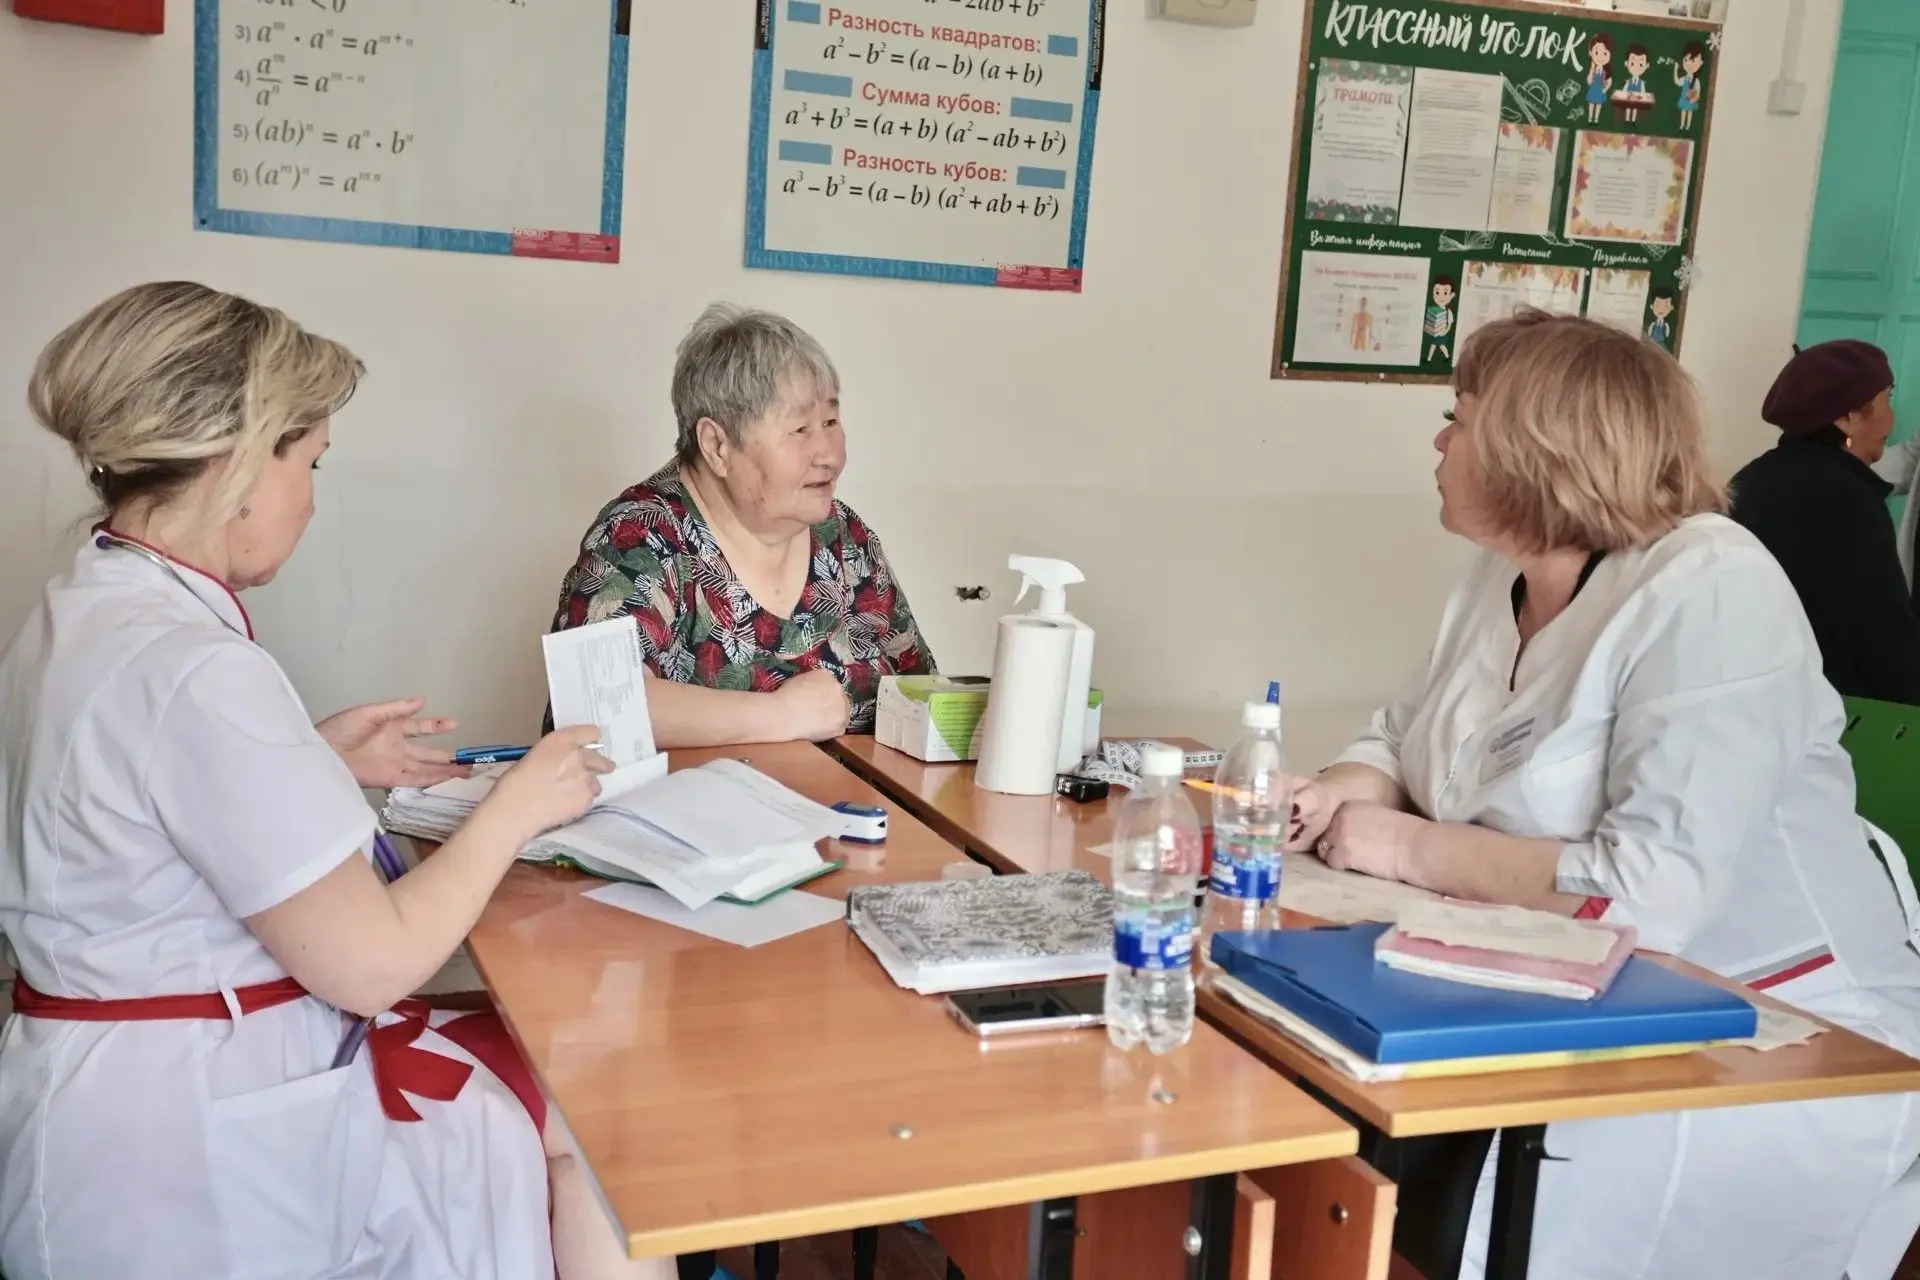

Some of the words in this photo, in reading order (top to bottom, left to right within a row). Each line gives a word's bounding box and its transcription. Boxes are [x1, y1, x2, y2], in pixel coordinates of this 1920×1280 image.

[828, 8, 924, 38] Разность
[931, 25, 1041, 53] квадратов:
[1324, 0, 1473, 52] КЛАССНЫЙ
[862, 82, 930, 107] Сумма
[937, 93, 1001, 115] кубов:
[843, 148, 937, 176] Разность
[943, 161, 1007, 183] кубов:
